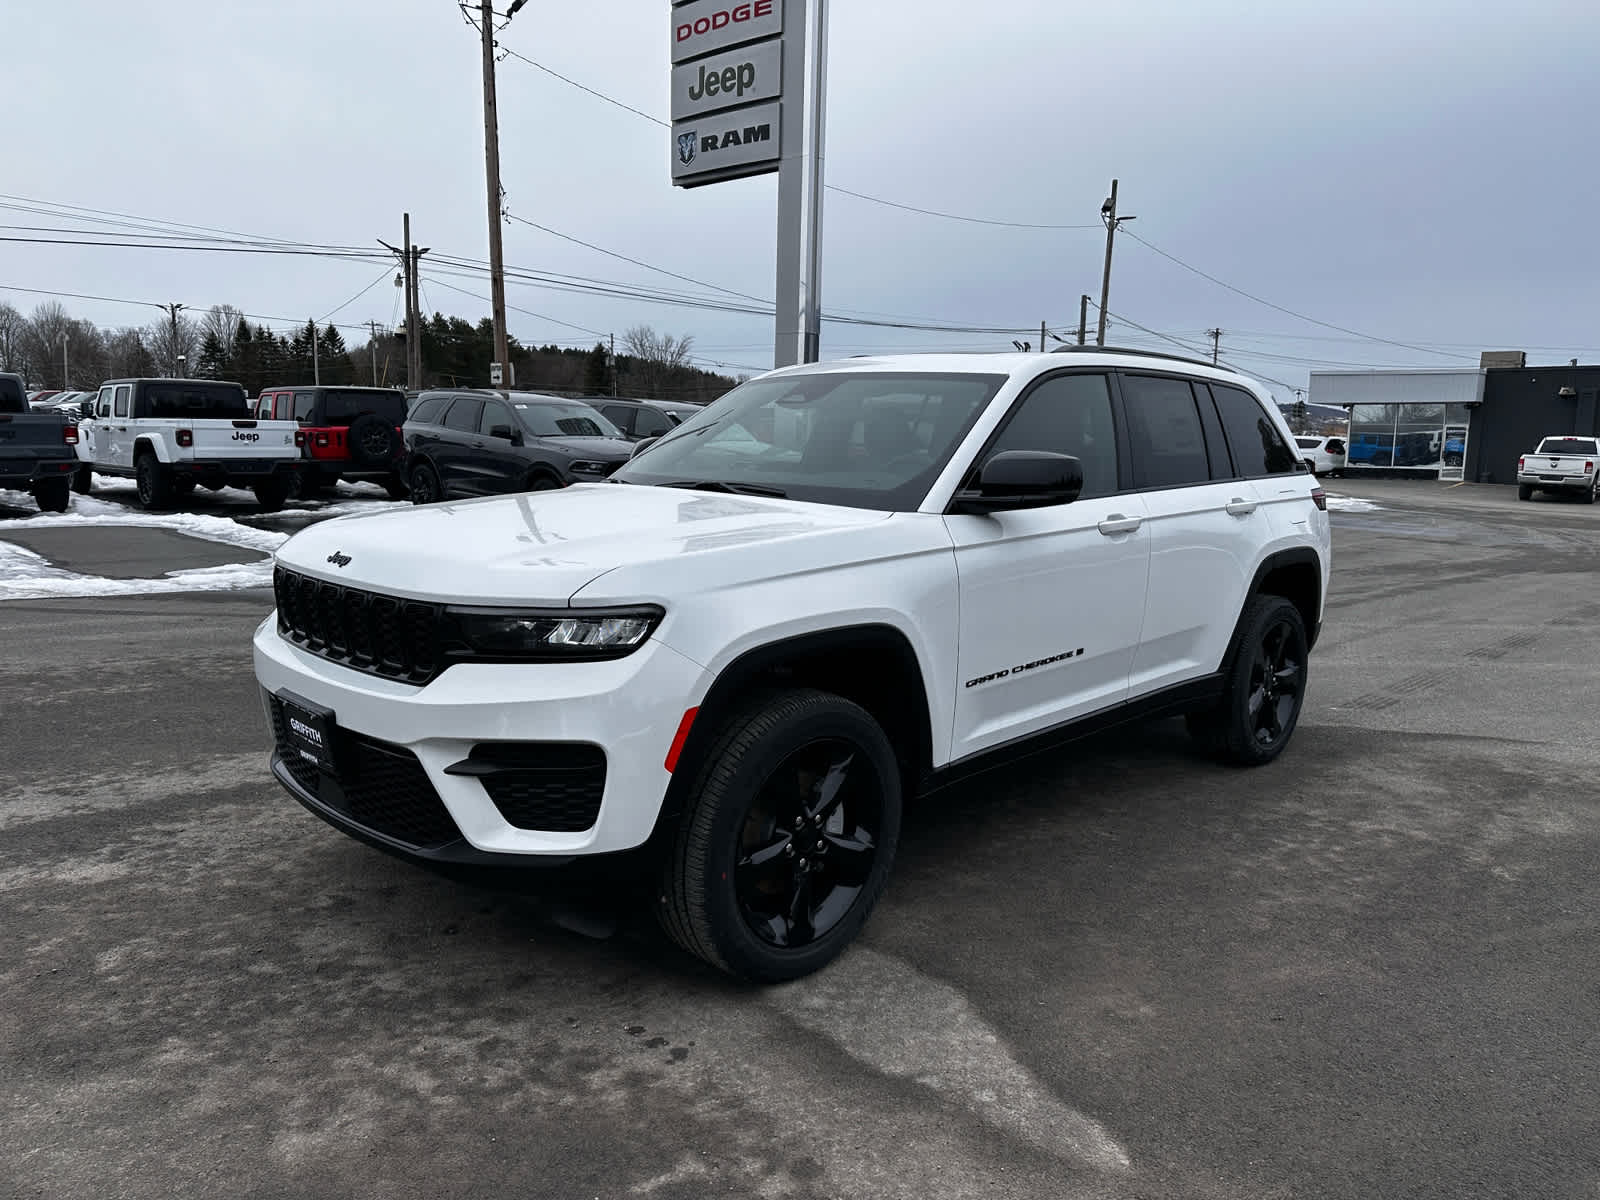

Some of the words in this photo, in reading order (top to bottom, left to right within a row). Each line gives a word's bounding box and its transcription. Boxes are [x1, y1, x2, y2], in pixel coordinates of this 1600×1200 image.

[676, 0, 772, 42] DODGE
[688, 62, 755, 100] Jeep
[701, 124, 770, 152] RAM
[231, 431, 259, 442] Jeep
[327, 551, 352, 568] Jeep
[965, 669, 1009, 688] GRAND
[1012, 651, 1074, 674] CHEROKEE
[290, 718, 322, 743] GRIFFITH
